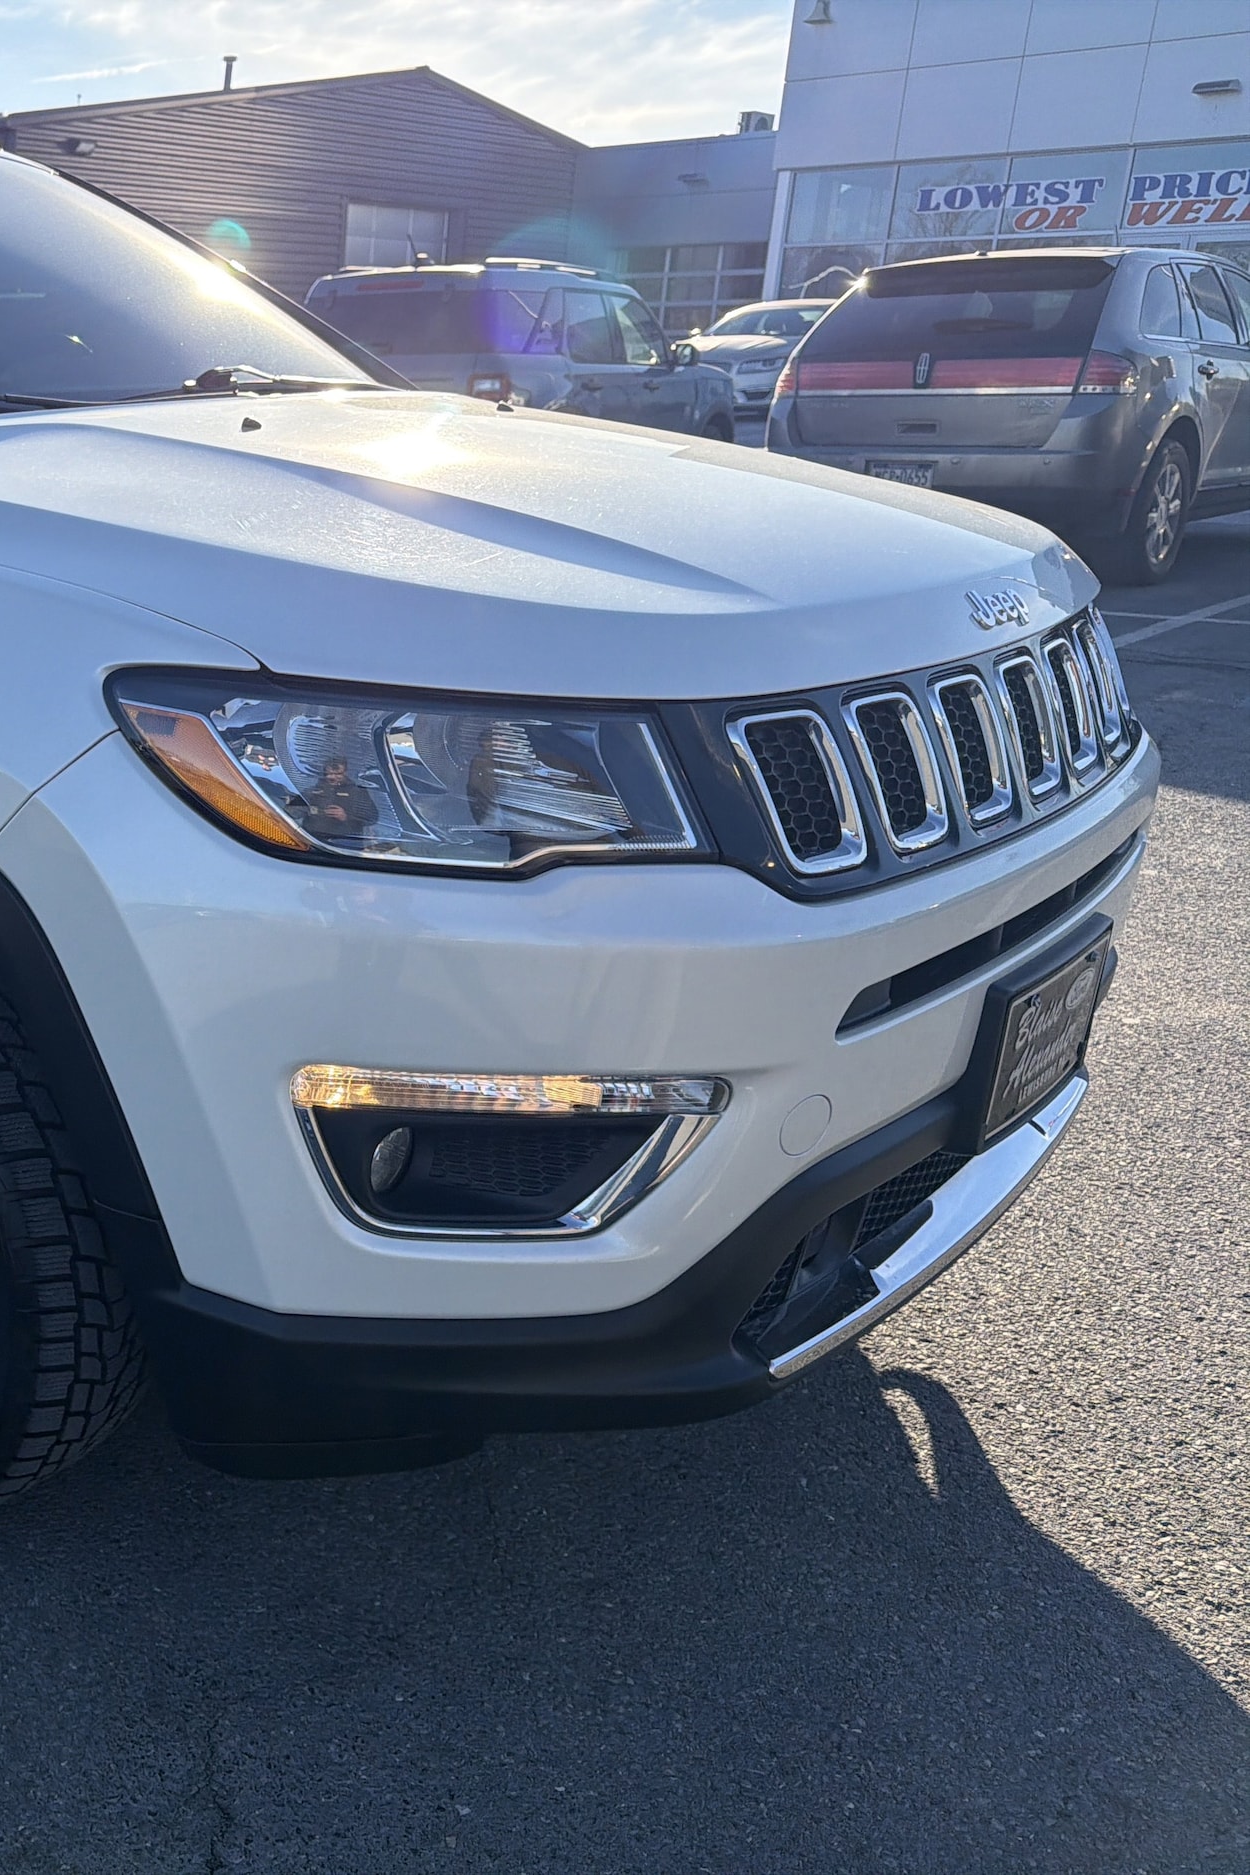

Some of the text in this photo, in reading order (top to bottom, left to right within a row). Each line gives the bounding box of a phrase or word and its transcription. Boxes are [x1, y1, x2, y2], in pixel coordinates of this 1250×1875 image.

[916, 169, 1250, 212] LOWEST PRIC
[1014, 205, 1087, 230] OR
[964, 588, 1029, 630] Jeep
